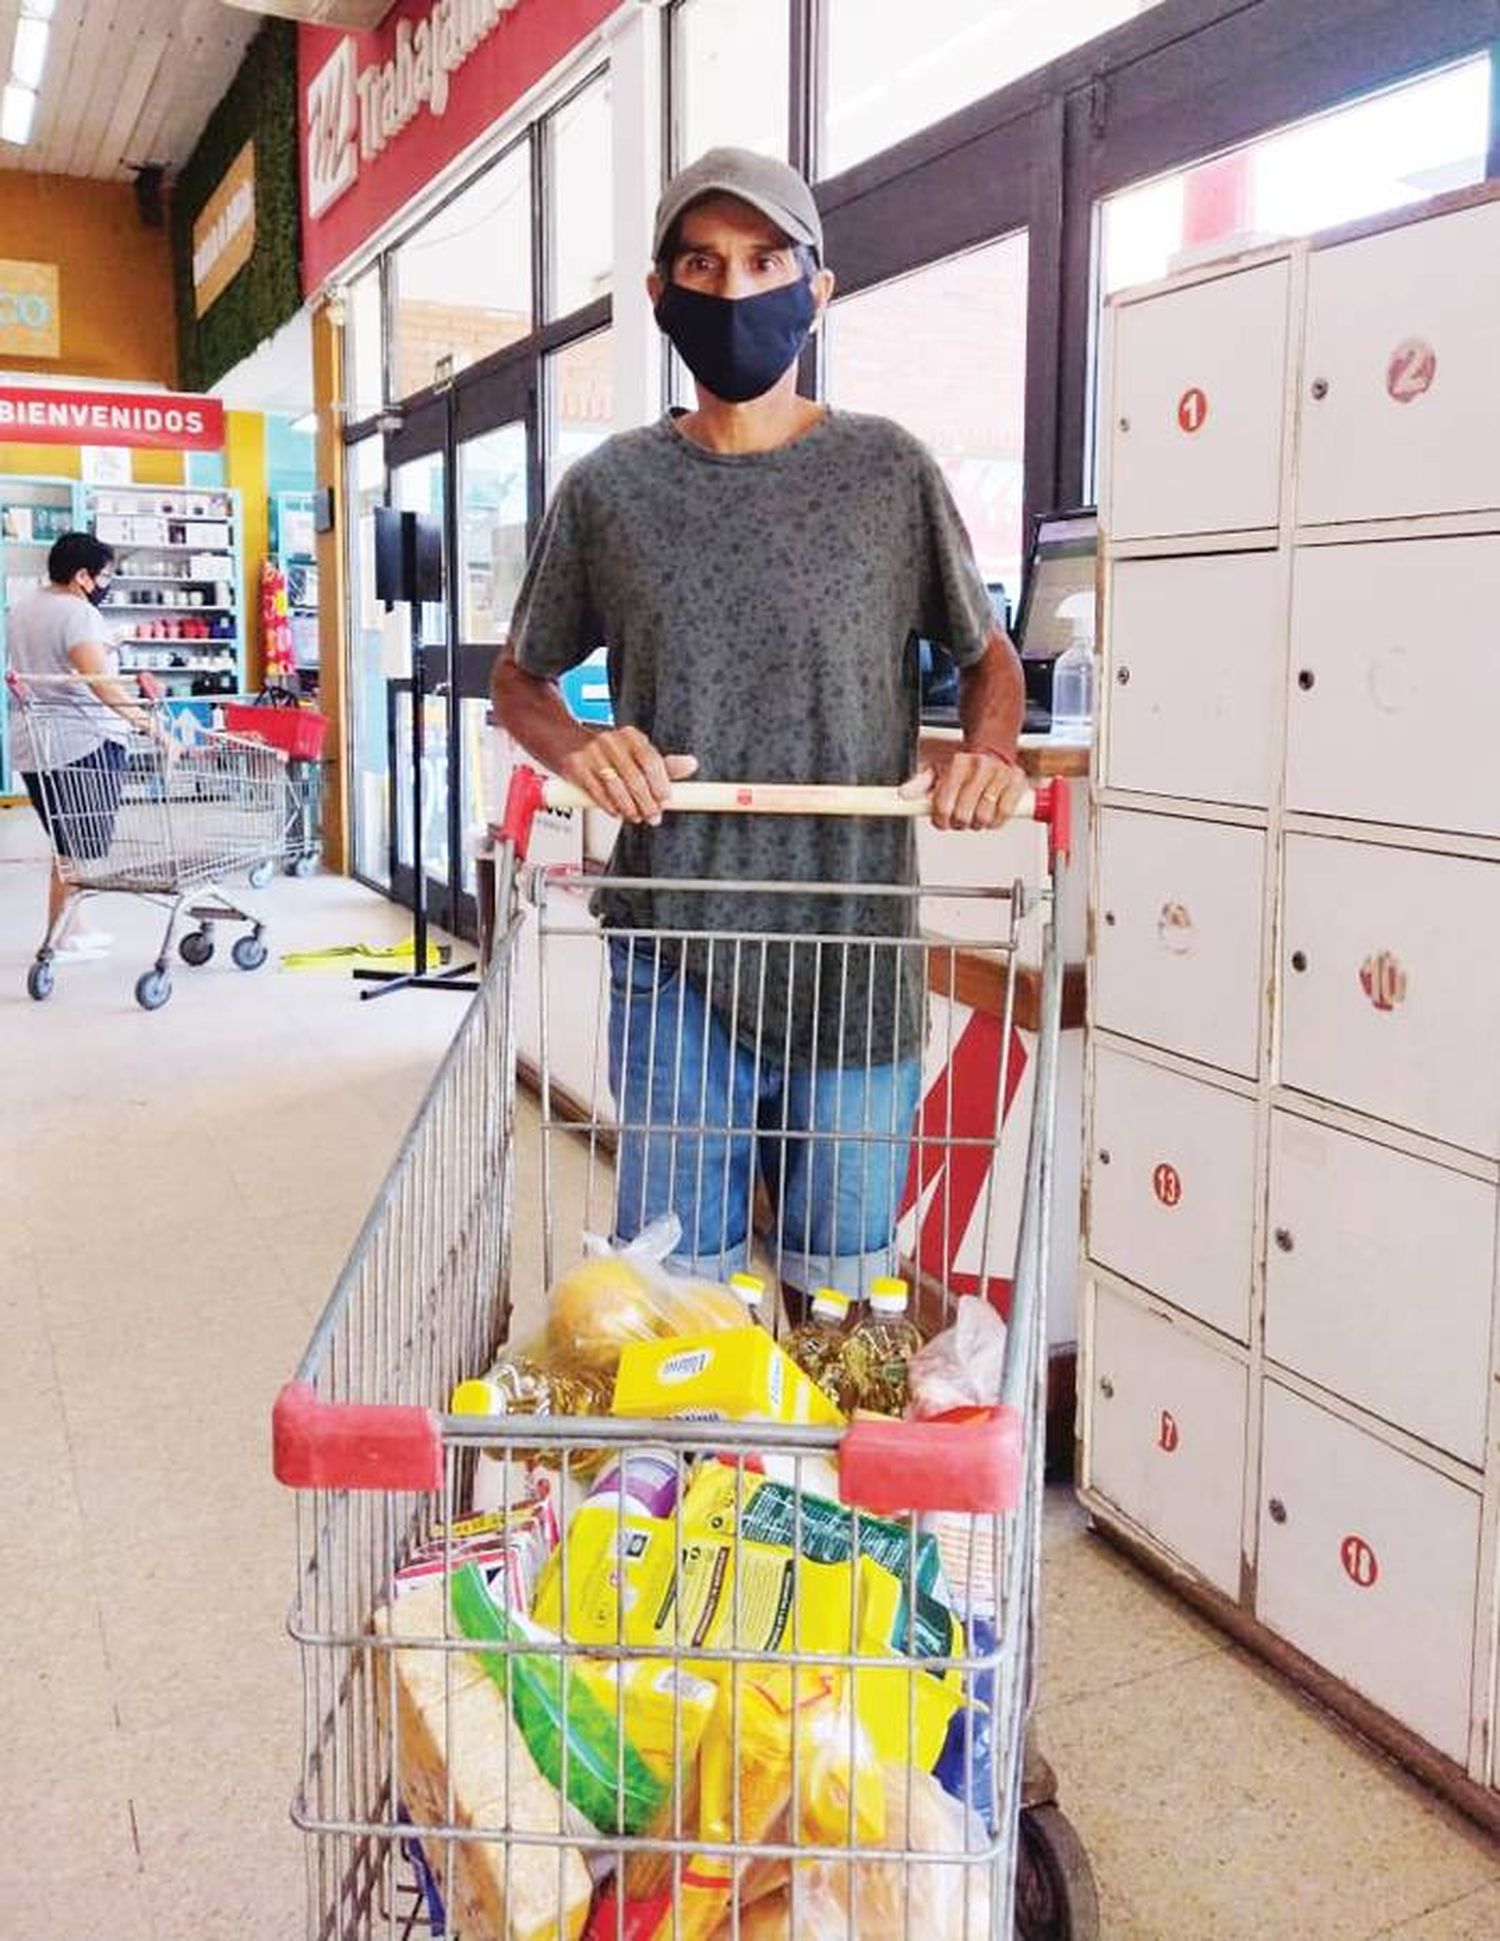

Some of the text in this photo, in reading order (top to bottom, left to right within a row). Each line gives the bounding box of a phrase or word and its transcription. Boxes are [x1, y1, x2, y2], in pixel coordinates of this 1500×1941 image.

[1392, 343, 1428, 397] 2
[0, 400, 205, 434] BIENVENIDOS
[1181, 391, 1199, 429] 1
[1157, 1166, 1177, 1203] 13
